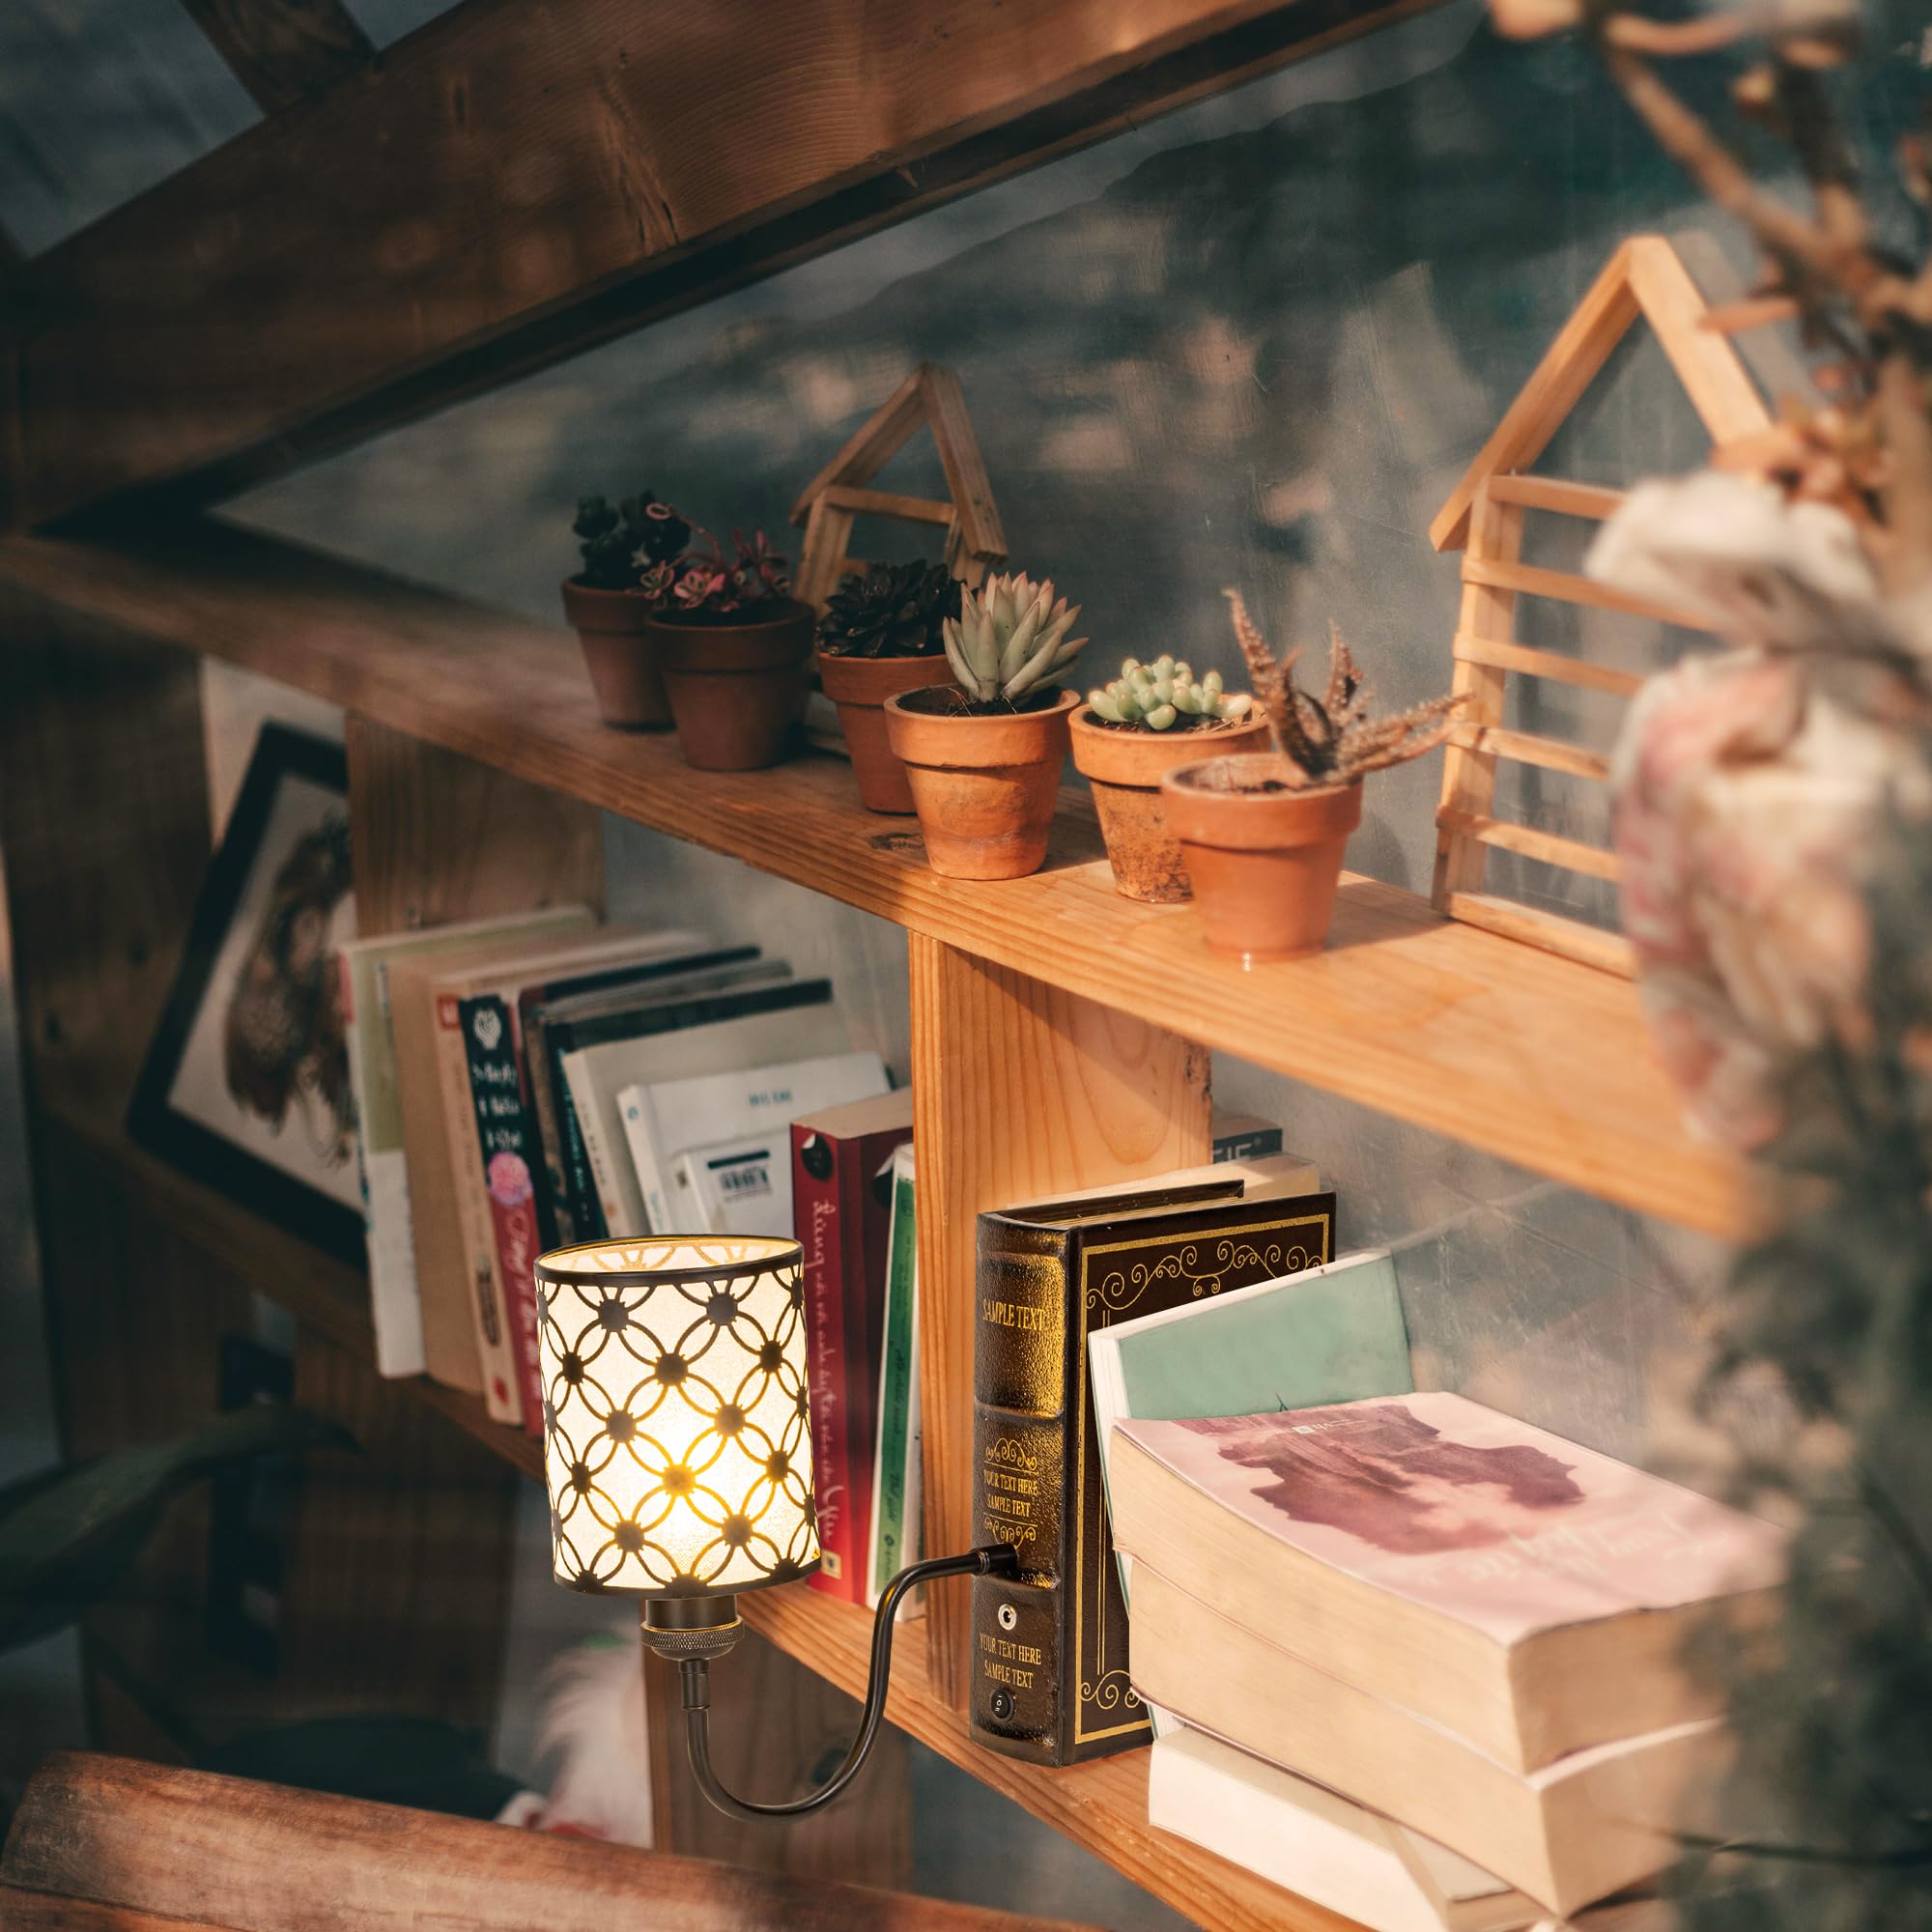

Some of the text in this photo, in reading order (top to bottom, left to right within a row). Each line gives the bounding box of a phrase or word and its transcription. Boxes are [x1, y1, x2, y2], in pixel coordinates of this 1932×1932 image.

[982, 1298, 1045, 1331] SAMPLE TEXT
[1000, 1473, 1017, 1492] TEXT
[1017, 1479, 1038, 1496] HERE
[988, 1493, 1031, 1518] SAMPLE TEXT
[980, 1633, 1041, 1665] YOUR TEXT HERE
[984, 1660, 1034, 1689] SAMPLE TEXT
